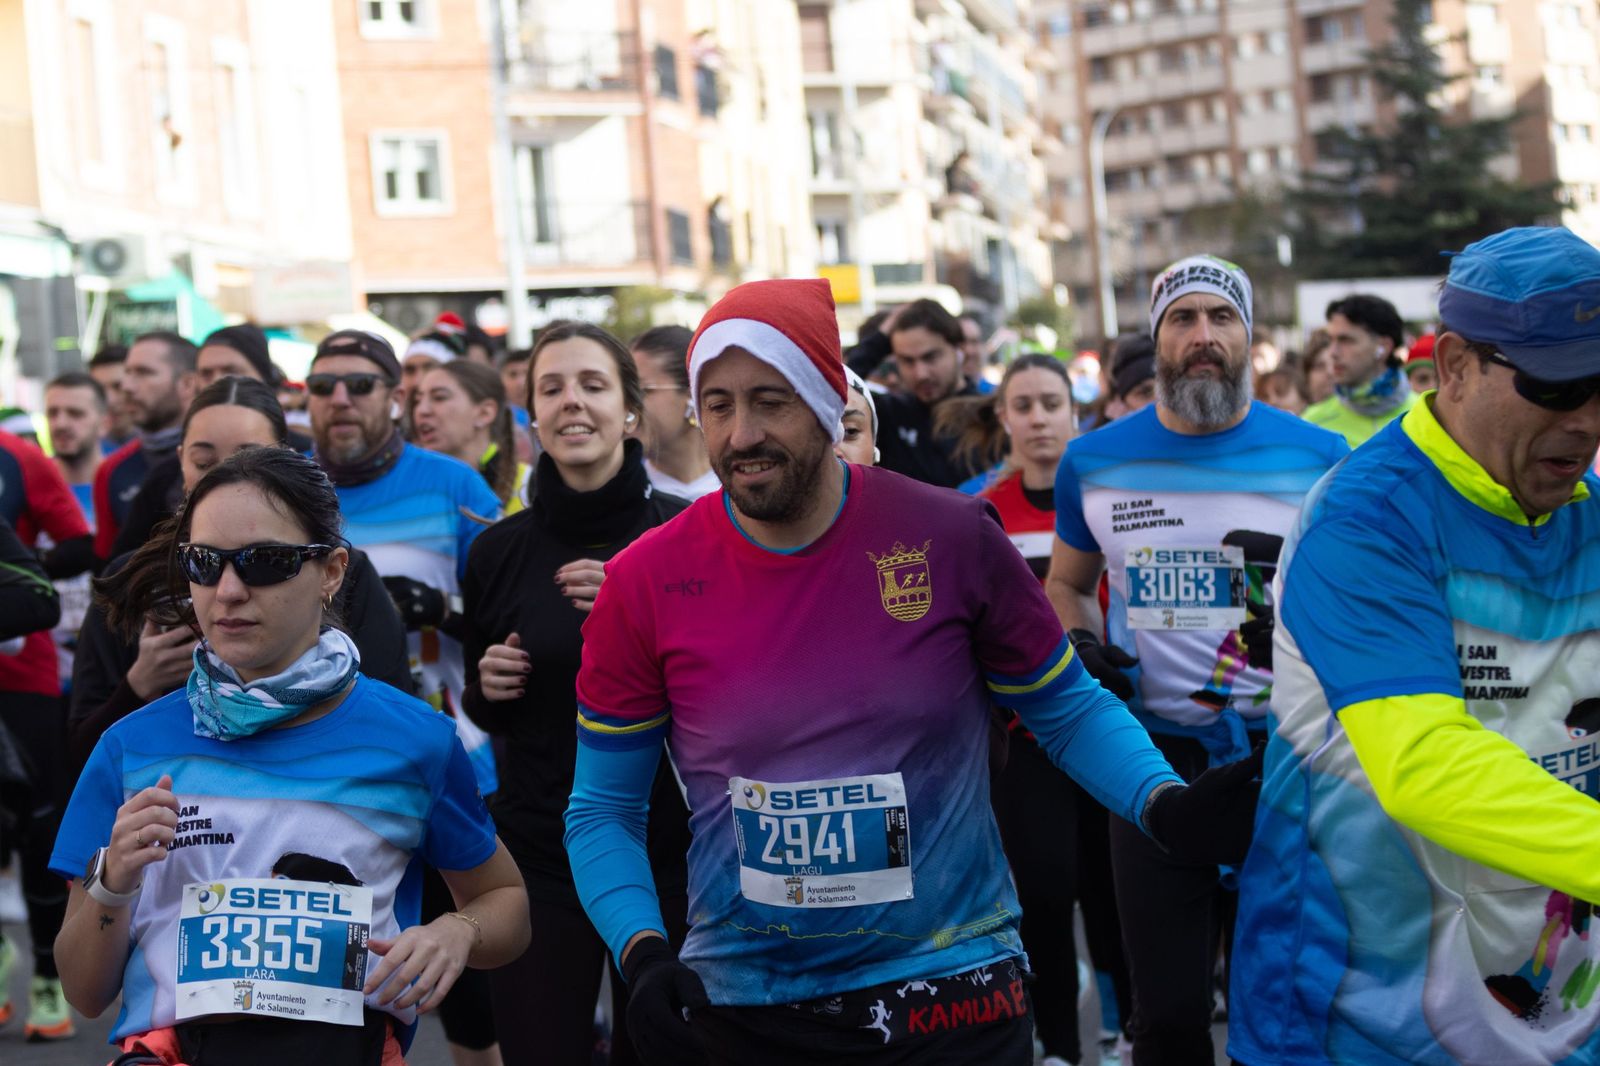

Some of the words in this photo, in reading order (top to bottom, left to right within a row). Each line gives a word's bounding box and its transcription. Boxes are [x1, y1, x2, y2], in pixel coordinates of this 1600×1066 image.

[1112, 503, 1127, 512] XLI
[1130, 499, 1153, 508] SAN
[1112, 508, 1165, 523] SILVESTRE
[1112, 518, 1184, 534] SALMANTINA
[1139, 568, 1216, 602] 3063
[1468, 645, 1497, 660] SAN
[1459, 666, 1511, 680] VESTRE
[1464, 686, 1529, 700] MANTINA
[1531, 742, 1600, 774] ETEL
[769, 783, 887, 811] SETEL
[177, 805, 199, 817] AN
[174, 818, 212, 833] ESTRE
[167, 833, 235, 851] LMANTINA
[759, 812, 856, 865] 2941
[792, 866, 822, 876] LAGU
[807, 885, 856, 895] Ayuntamiento
[229, 887, 352, 916] SETEL
[818, 894, 856, 904] Salamanca
[201, 915, 323, 974] 3355
[244, 968, 276, 980] LARA
[256, 991, 306, 1005] Ayuntamiento
[256, 1002, 266, 1011] de
[267, 1003, 305, 1016] Salamanca
